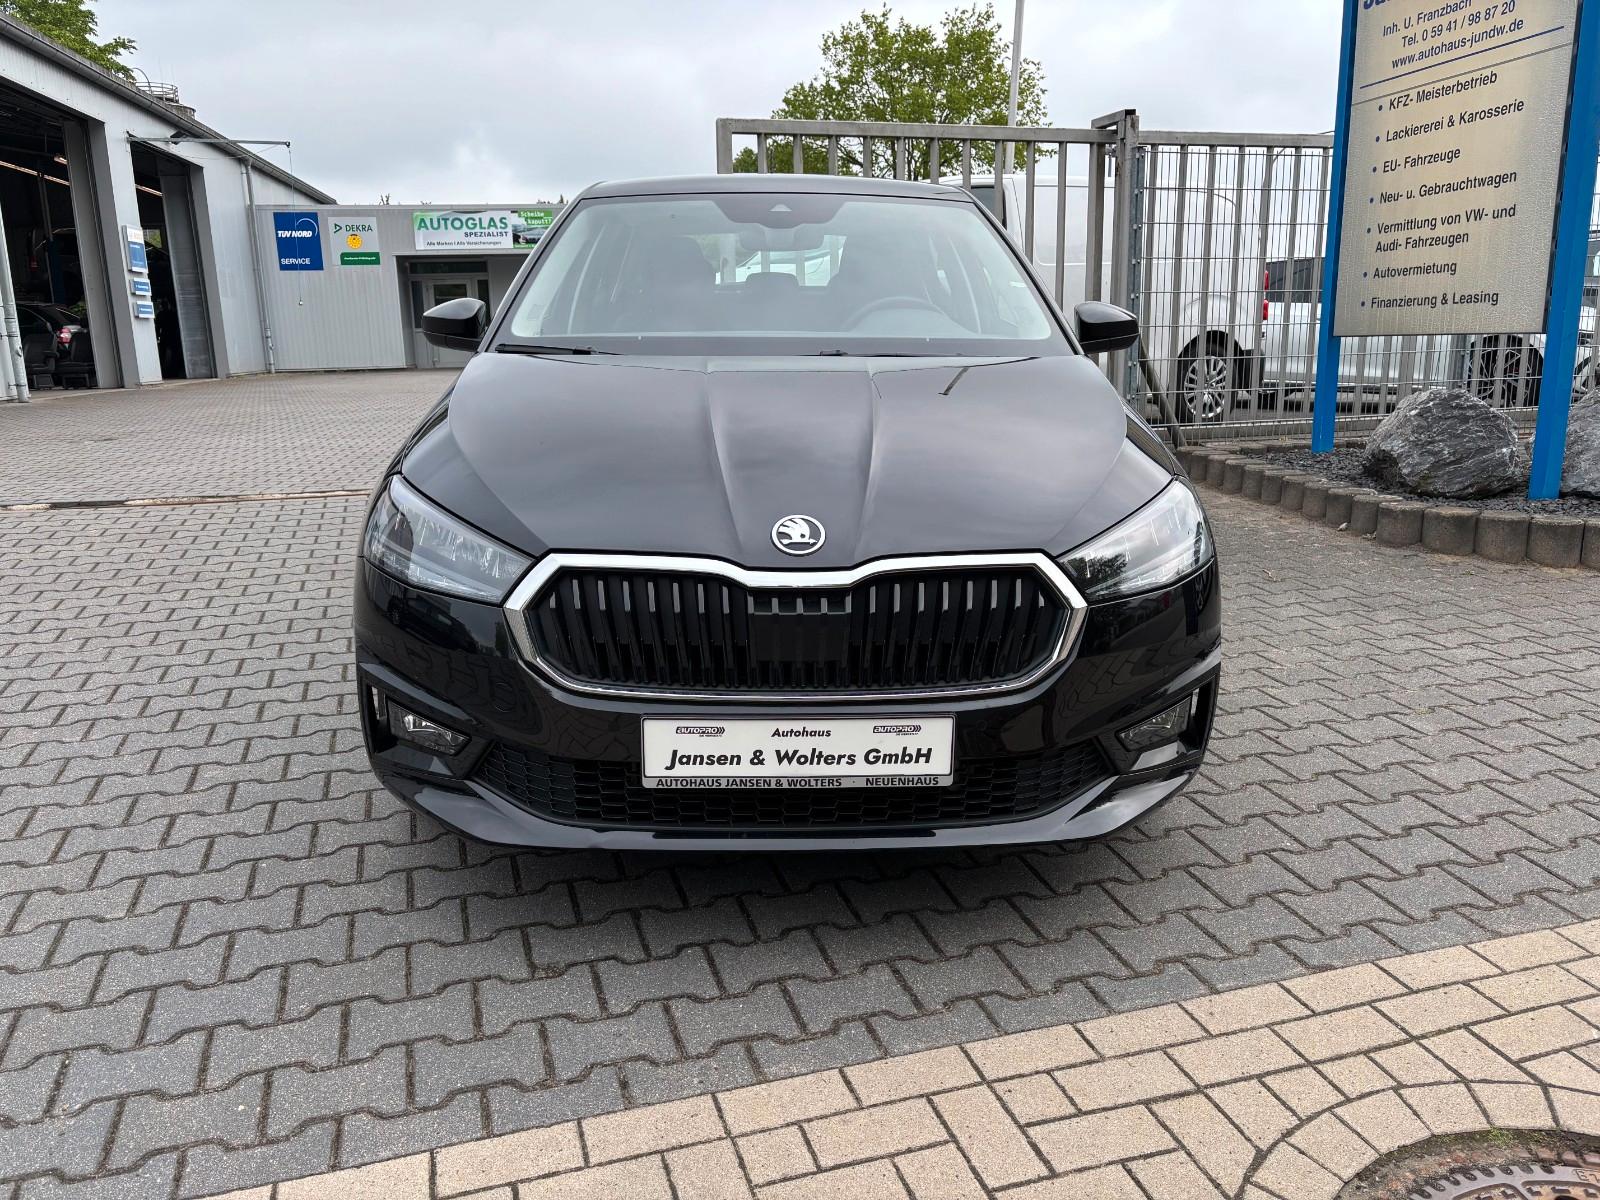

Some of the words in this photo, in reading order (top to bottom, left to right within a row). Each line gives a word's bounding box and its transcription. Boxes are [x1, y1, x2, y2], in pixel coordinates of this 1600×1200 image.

[1382, 21, 1401, 37] Inh.
[1403, 16, 1414, 30] U.
[1416, 0, 1471, 25] Franzbach
[1401, 32, 1419, 48] Tel.
[1422, 29, 1429, 42] 0
[1430, 25, 1443, 39] 59
[1445, 20, 1458, 34] 41
[1468, 11, 1481, 26] 98
[1484, 7, 1499, 21] 87
[1501, 1, 1515, 15] 20
[1391, 18, 1524, 69] www.autohaus-jundw.de
[1389, 97, 1414, 111] KFZ-
[1416, 71, 1497, 104] Meisterbetrieb
[1386, 116, 1444, 142] Lackiererei
[1447, 114, 1455, 128] &
[1459, 99, 1525, 124] Karosserie
[1382, 161, 1401, 174] EU-
[1403, 148, 1461, 170] Fahrzeuge
[1379, 191, 1404, 204] Neu-
[1406, 188, 1416, 200] u.
[1419, 171, 1517, 197] Gebrauchtwagen
[345, 223, 373, 232] DEKRA
[417, 217, 508, 230] AUTOGLAS
[1377, 217, 1437, 234] Vermittlung
[1440, 211, 1461, 226] von
[1465, 207, 1489, 222] VW-
[1492, 204, 1516, 219] und
[291, 230, 313, 238] NORD
[1375, 240, 1402, 253] Audi-
[1405, 232, 1469, 249] Fahrzeugen
[280, 257, 311, 265] SERVICE
[1373, 262, 1457, 279] Autovermietung
[1370, 294, 1438, 309] Finanzierung
[1440, 292, 1448, 305] &
[1452, 291, 1499, 306] Leasing
[771, 727, 831, 738] Autohaus
[664, 749, 742, 771] Jansen
[749, 749, 766, 766] &
[775, 748, 856, 766] Wolters
[863, 746, 933, 765] GmbH
[656, 779, 722, 788] AUTOHAUS
[725, 778, 772, 788] JANSEN
[774, 779, 784, 788] &
[787, 778, 842, 788] WOLTERS
[865, 776, 939, 787] NEUENHAUS
